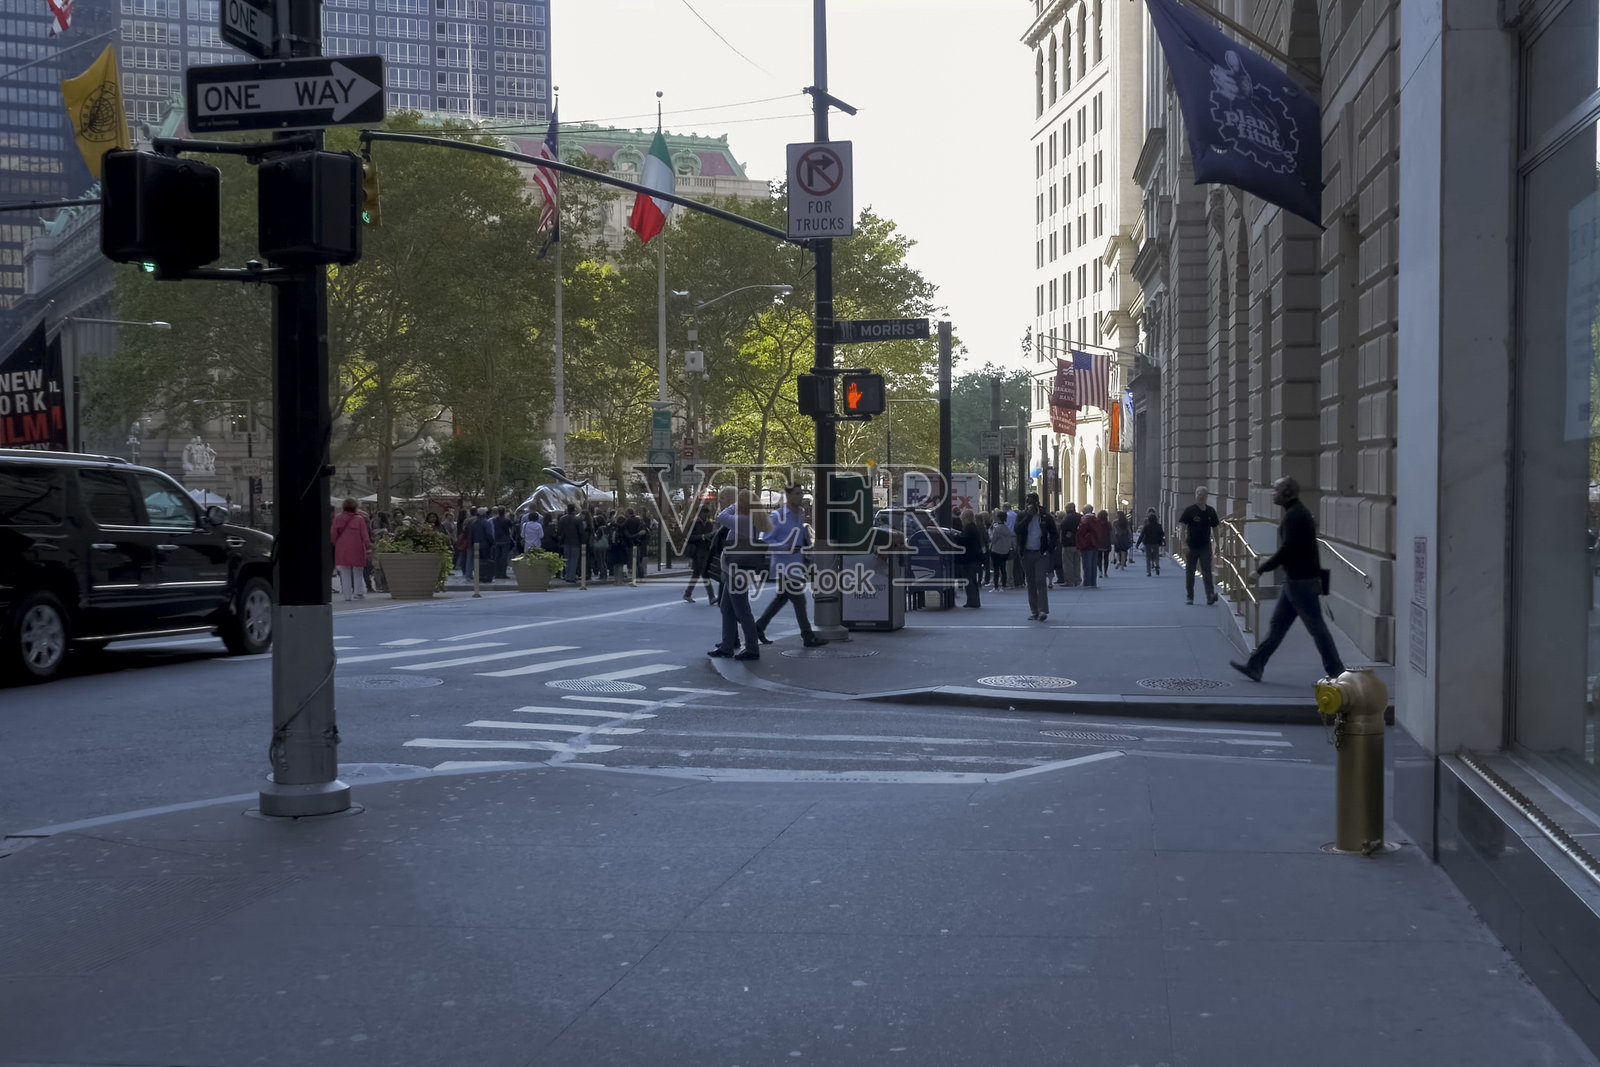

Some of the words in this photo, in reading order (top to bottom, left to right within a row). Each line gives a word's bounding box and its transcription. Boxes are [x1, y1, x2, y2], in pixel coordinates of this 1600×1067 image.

[229, 0, 257, 37] ONE
[204, 84, 261, 112] ONE
[294, 78, 357, 107] WAY
[1224, 108, 1280, 141] plant
[808, 200, 832, 215] FOR
[796, 217, 845, 232] TRUCKS
[860, 323, 916, 338] MORRIS
[0, 368, 43, 393] NEW
[0, 391, 48, 416] ORK
[0, 412, 49, 445] ILM
